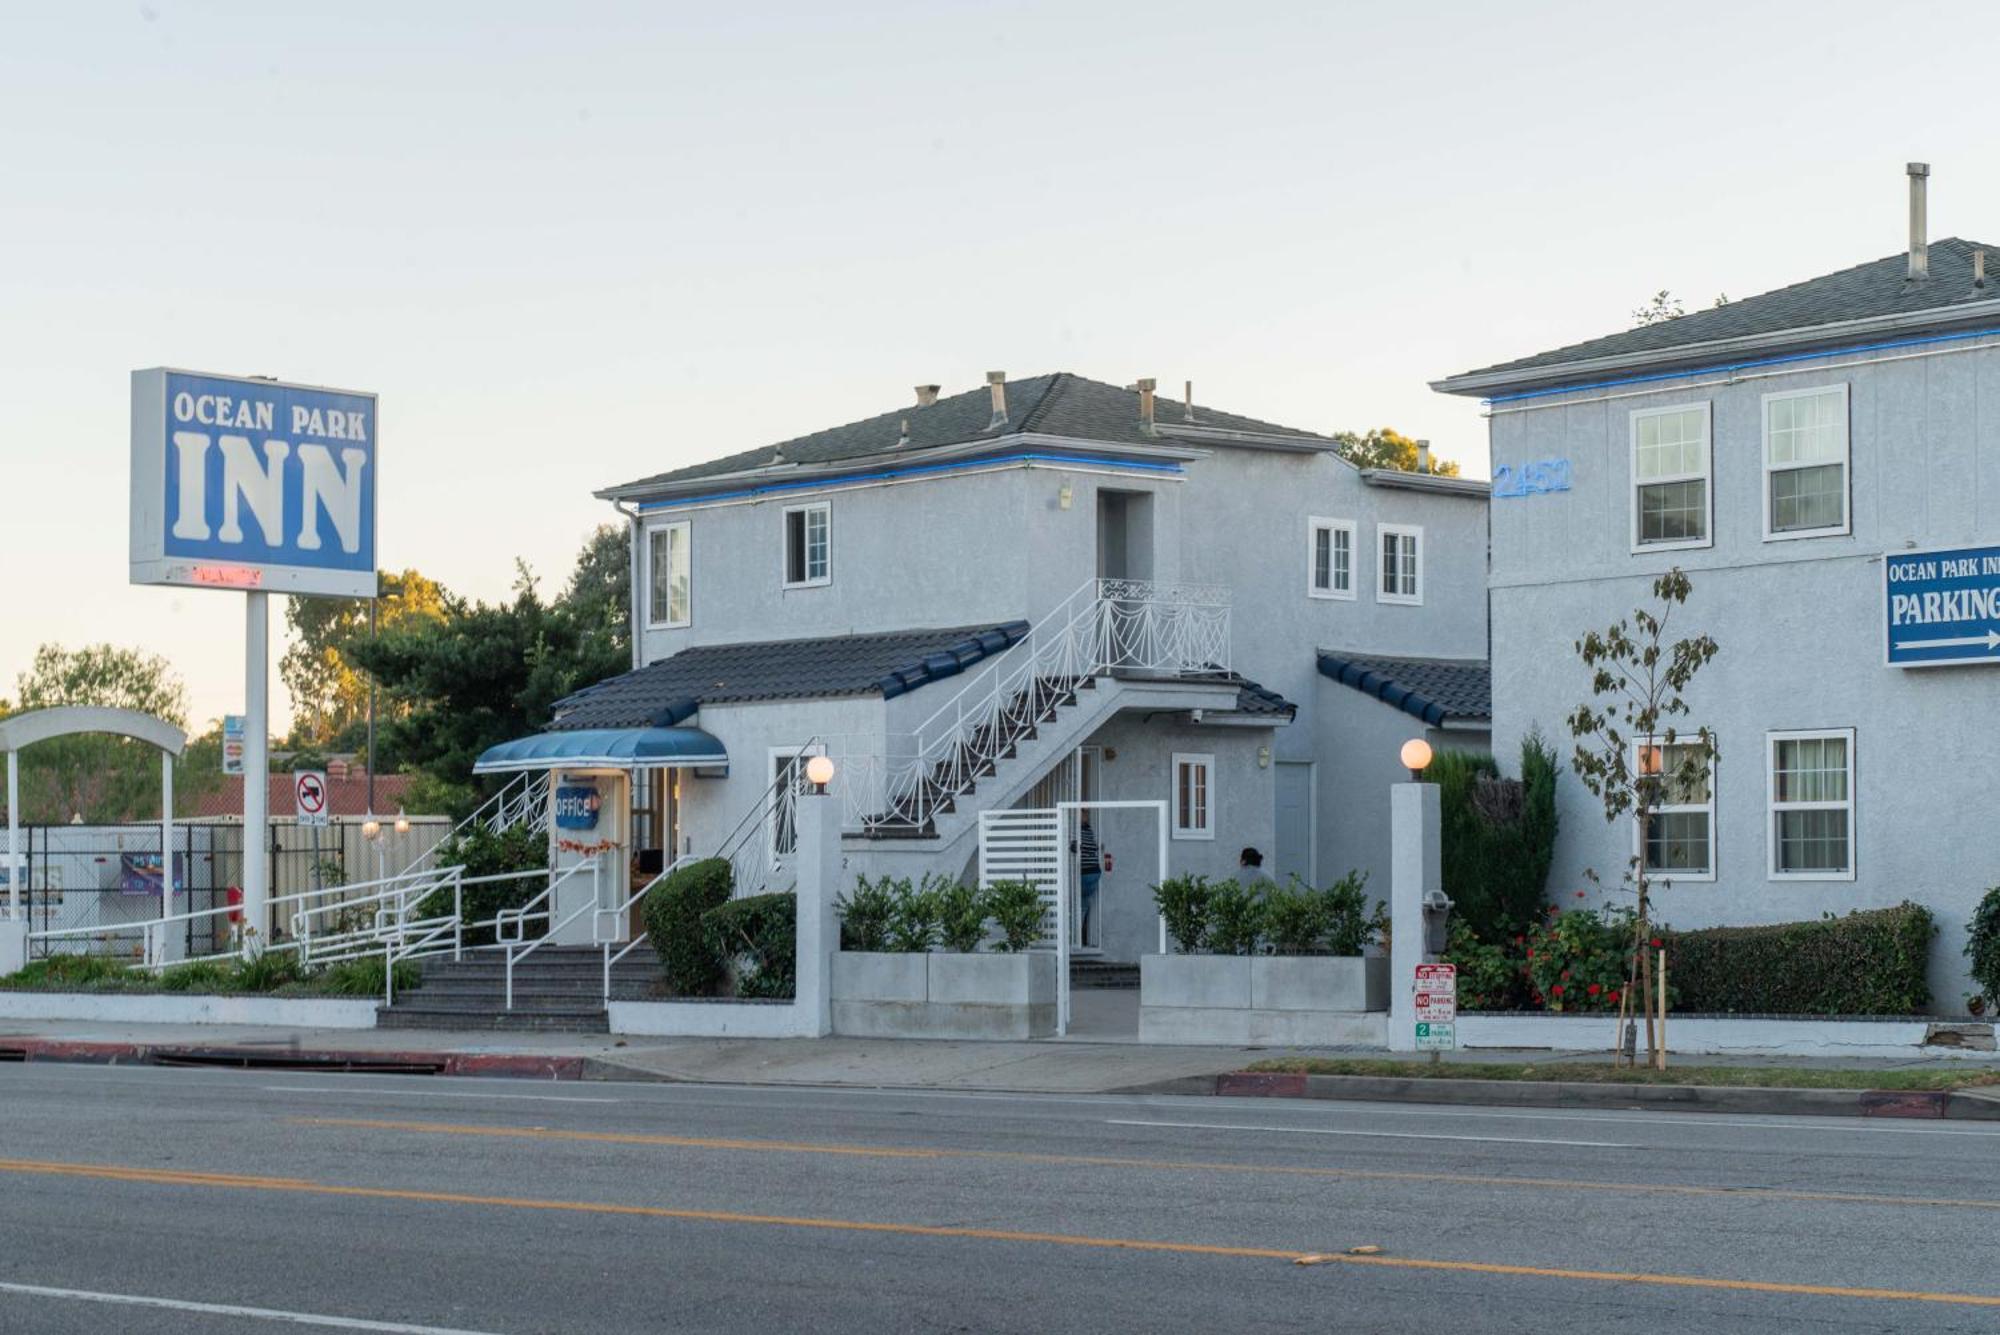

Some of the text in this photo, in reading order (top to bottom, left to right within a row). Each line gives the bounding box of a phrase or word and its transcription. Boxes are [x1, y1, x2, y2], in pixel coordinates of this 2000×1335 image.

[174, 392, 367, 441] OCEAN PARK
[1493, 458, 1571, 497] 2452
[172, 431, 367, 554] INN
[1889, 557, 2000, 582] OCEAN PARK IN
[556, 796, 591, 817] OFFICE
[1417, 996, 1429, 1006] NO
[1419, 1024, 1426, 1035] 2
